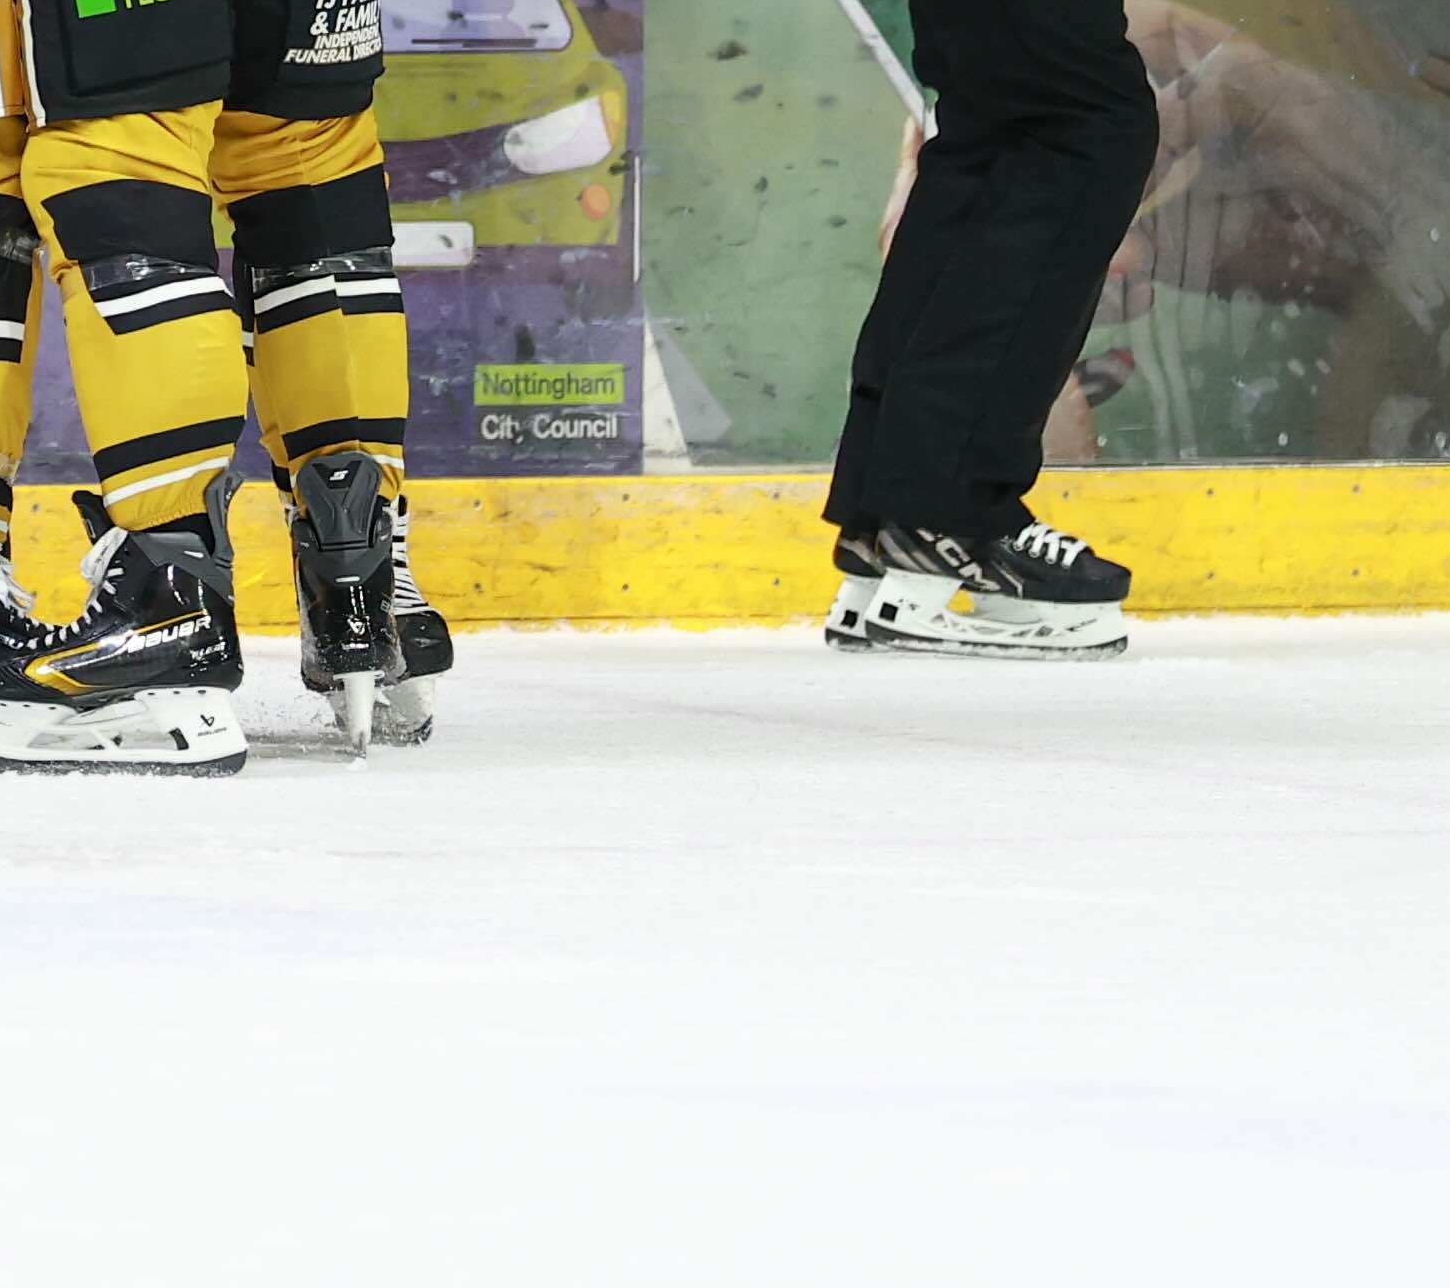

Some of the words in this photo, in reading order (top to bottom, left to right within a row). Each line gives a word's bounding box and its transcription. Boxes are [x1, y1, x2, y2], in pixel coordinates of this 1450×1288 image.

[309, 10, 330, 36] &
[314, 25, 380, 50] INDEPENDEN
[283, 47, 352, 65] FUNERAL
[481, 372, 617, 399] Nottingham
[532, 411, 619, 441] Council
[123, 614, 212, 655] BAUER
